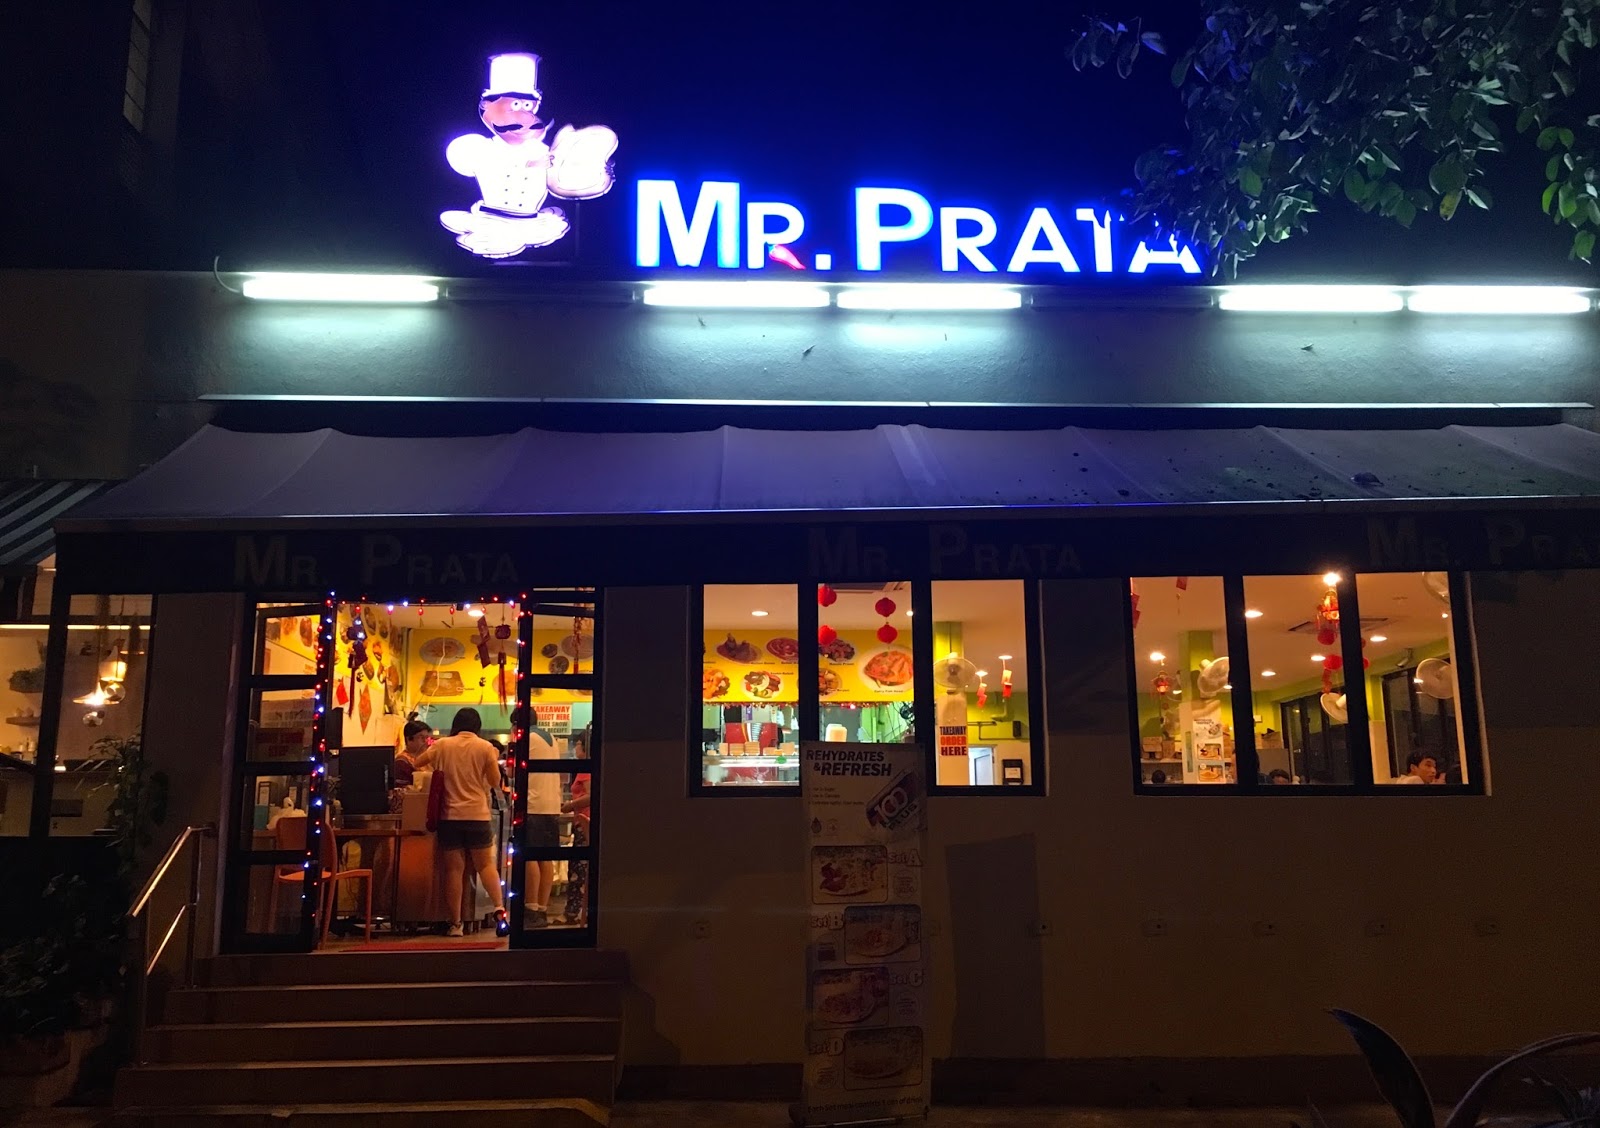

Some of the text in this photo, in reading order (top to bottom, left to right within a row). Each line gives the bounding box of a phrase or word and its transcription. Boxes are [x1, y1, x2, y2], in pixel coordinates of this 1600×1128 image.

[636, 178, 1202, 273] MR. PRATA
[1486, 515, 1600, 566] PRA
[928, 522, 1082, 576] PRATA
[233, 533, 519, 585] MR. PRATA
[556, 713, 570, 721] HERE
[940, 726, 967, 735] TAKEAWAY
[940, 736, 967, 745] ORDER
[806, 750, 885, 761] REHYDRATES
[941, 746, 967, 756] HERE
